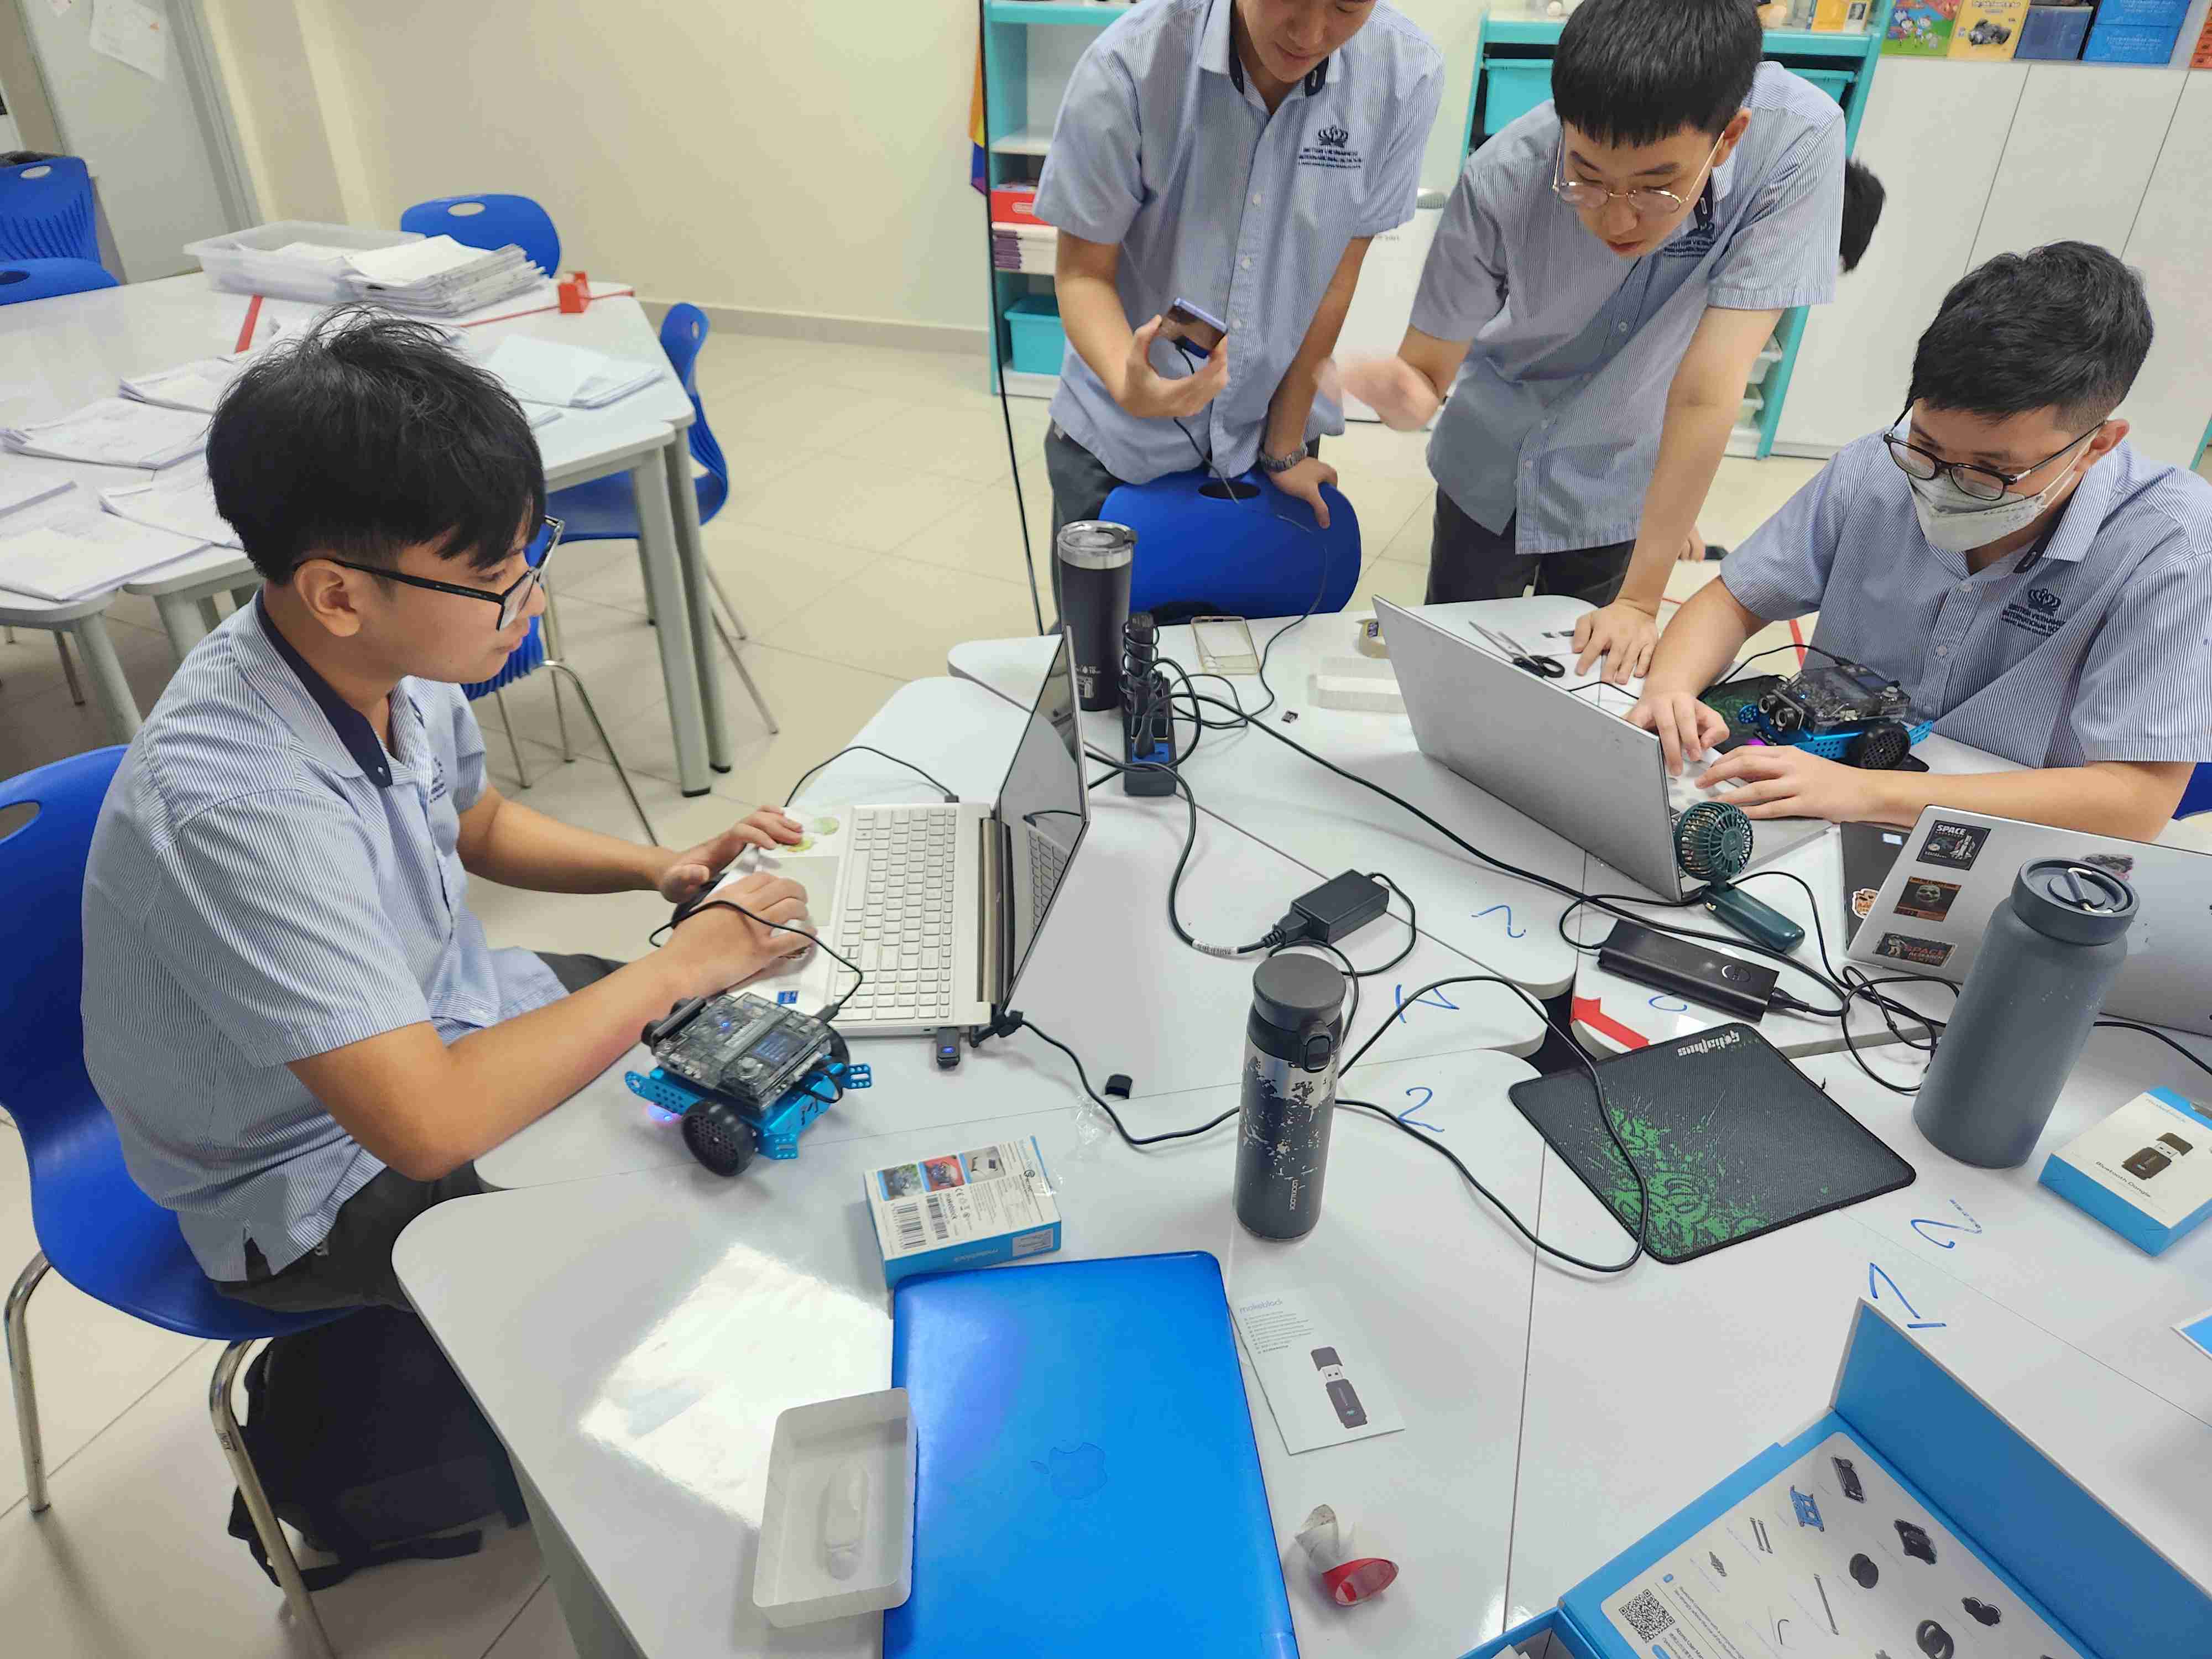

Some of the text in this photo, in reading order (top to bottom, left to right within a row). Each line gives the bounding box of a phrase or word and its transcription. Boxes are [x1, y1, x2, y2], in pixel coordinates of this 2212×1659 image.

[1936, 824, 1966, 836] SPACE
[1397, 1086, 1445, 1133] 2
[2095, 1161, 2151, 1198] Bluetooth Dongle
[1238, 1298, 1284, 1314] makeblock
